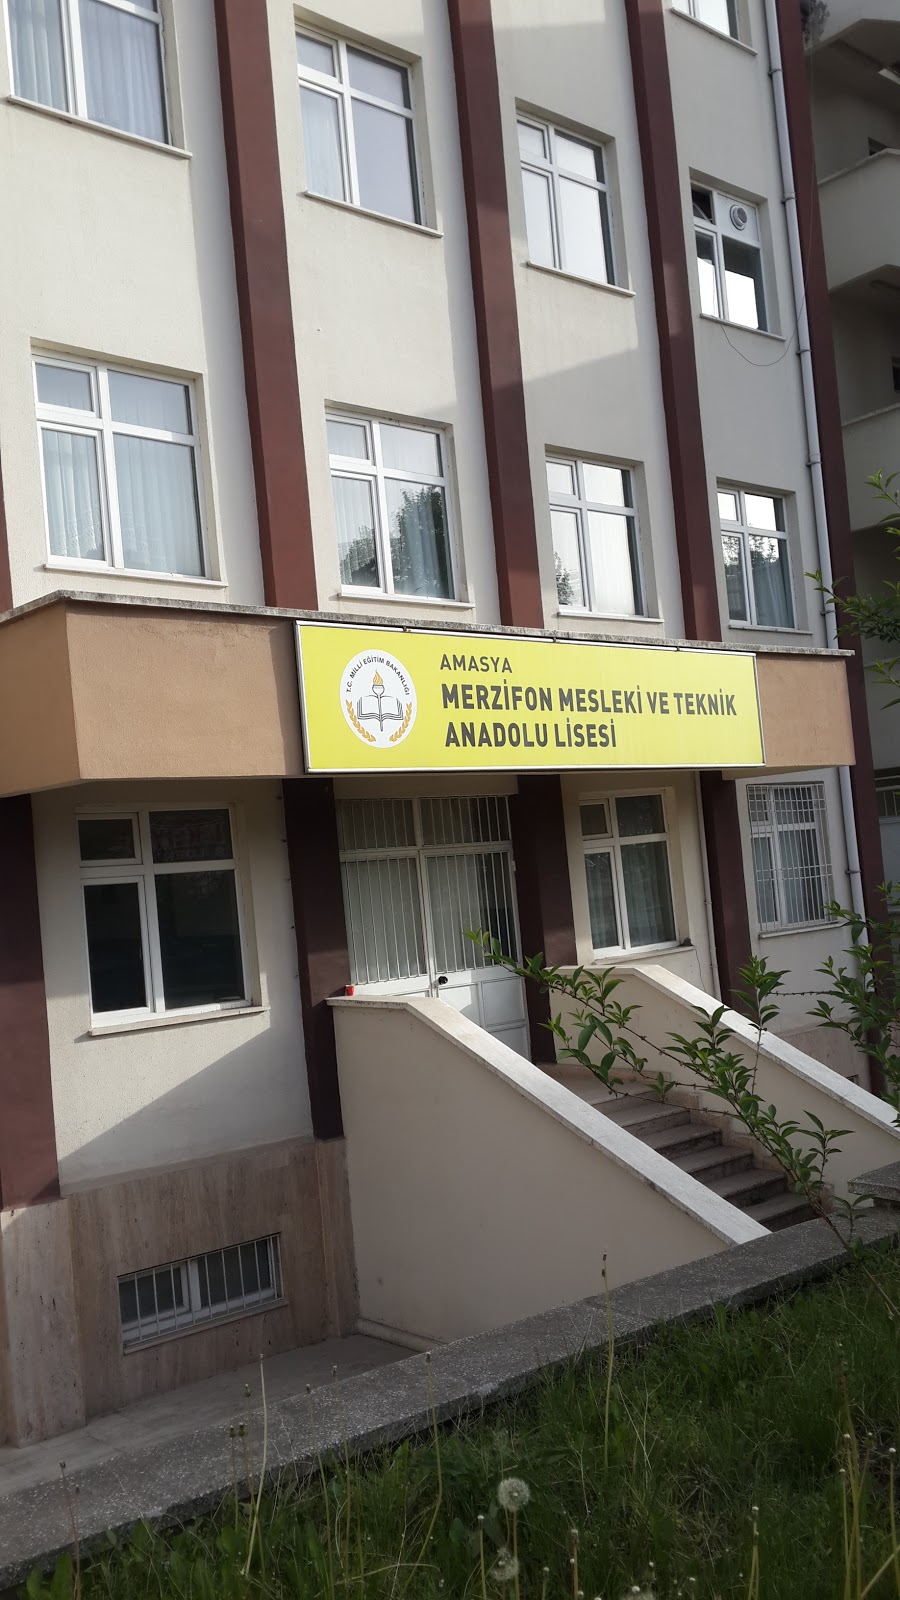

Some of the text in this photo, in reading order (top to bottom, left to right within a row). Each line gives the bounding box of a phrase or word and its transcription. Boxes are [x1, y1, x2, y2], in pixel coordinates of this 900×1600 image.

[349, 660, 363, 679] MİLLİ
[363, 655, 385, 665] EĞİTİM
[385, 660, 410, 695] BAKANLIĞI
[440, 653, 513, 673] AMASYA
[441, 679, 737, 716] MERZİFON MESLEKİ VE TEKNİK
[445, 717, 617, 748] ANADOLU LİSESİ
